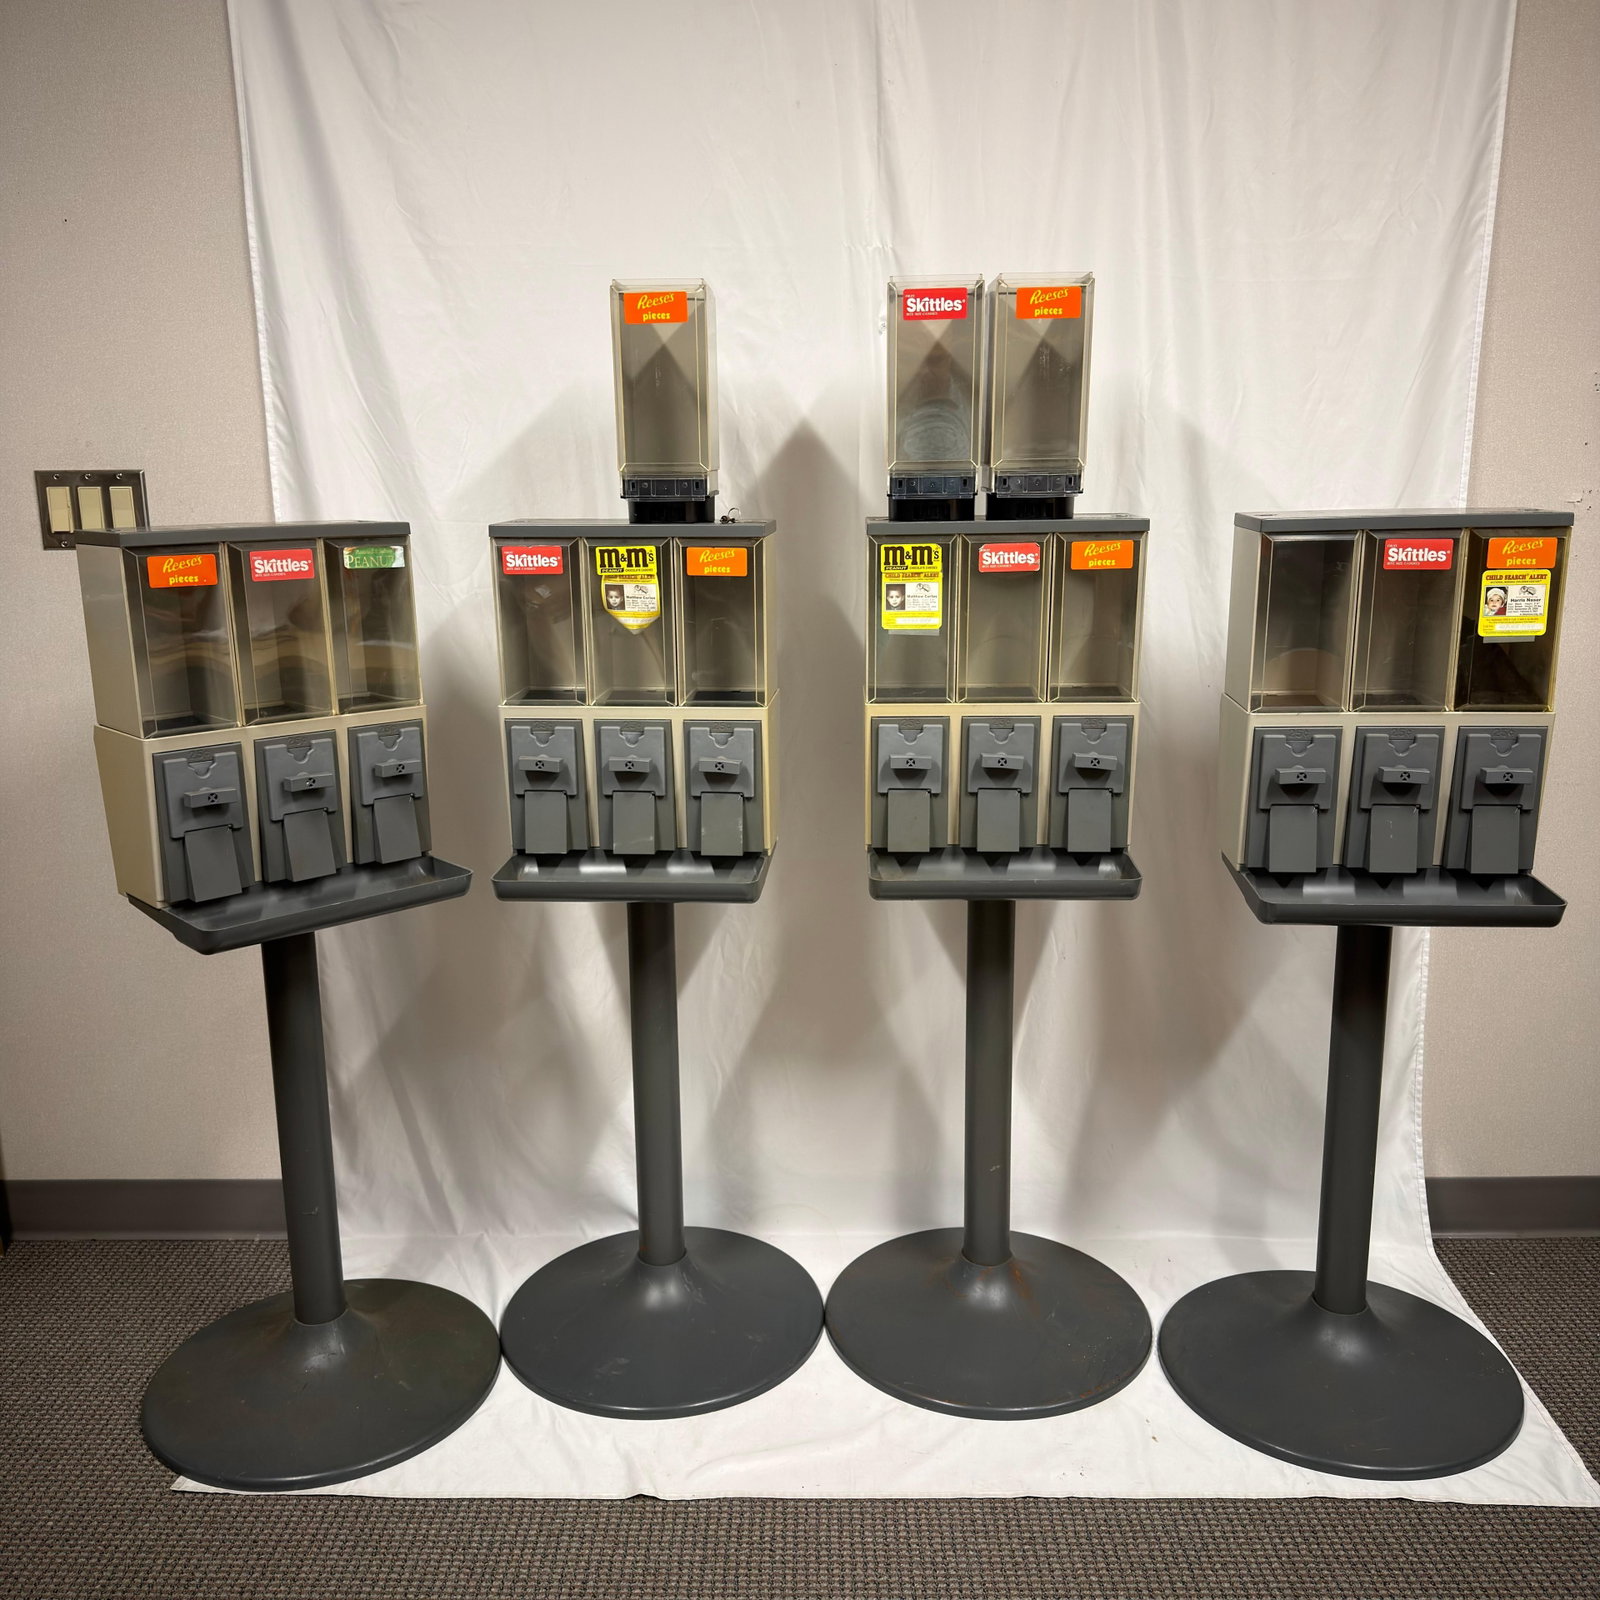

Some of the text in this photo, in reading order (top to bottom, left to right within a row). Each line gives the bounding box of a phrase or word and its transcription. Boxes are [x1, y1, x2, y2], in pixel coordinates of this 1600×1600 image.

[637, 293, 674, 310] Reese's
[1030, 288, 1069, 304] Reese's
[907, 297, 962, 312] Skittles
[642, 312, 670, 322] pieces
[1034, 306, 1062, 317] pieces
[1502, 540, 1544, 554] Reese's
[506, 554, 558, 567] Skittles
[982, 552, 1035, 565] Skittles
[1388, 548, 1446, 562] Skittles
[1506, 557, 1536, 566] pieces
[162, 555, 203, 573] Reese's
[254, 558, 309, 573] Skittles
[704, 564, 730, 574] pieces
[1088, 558, 1116, 568] pieces
[168, 574, 198, 585] pieces
